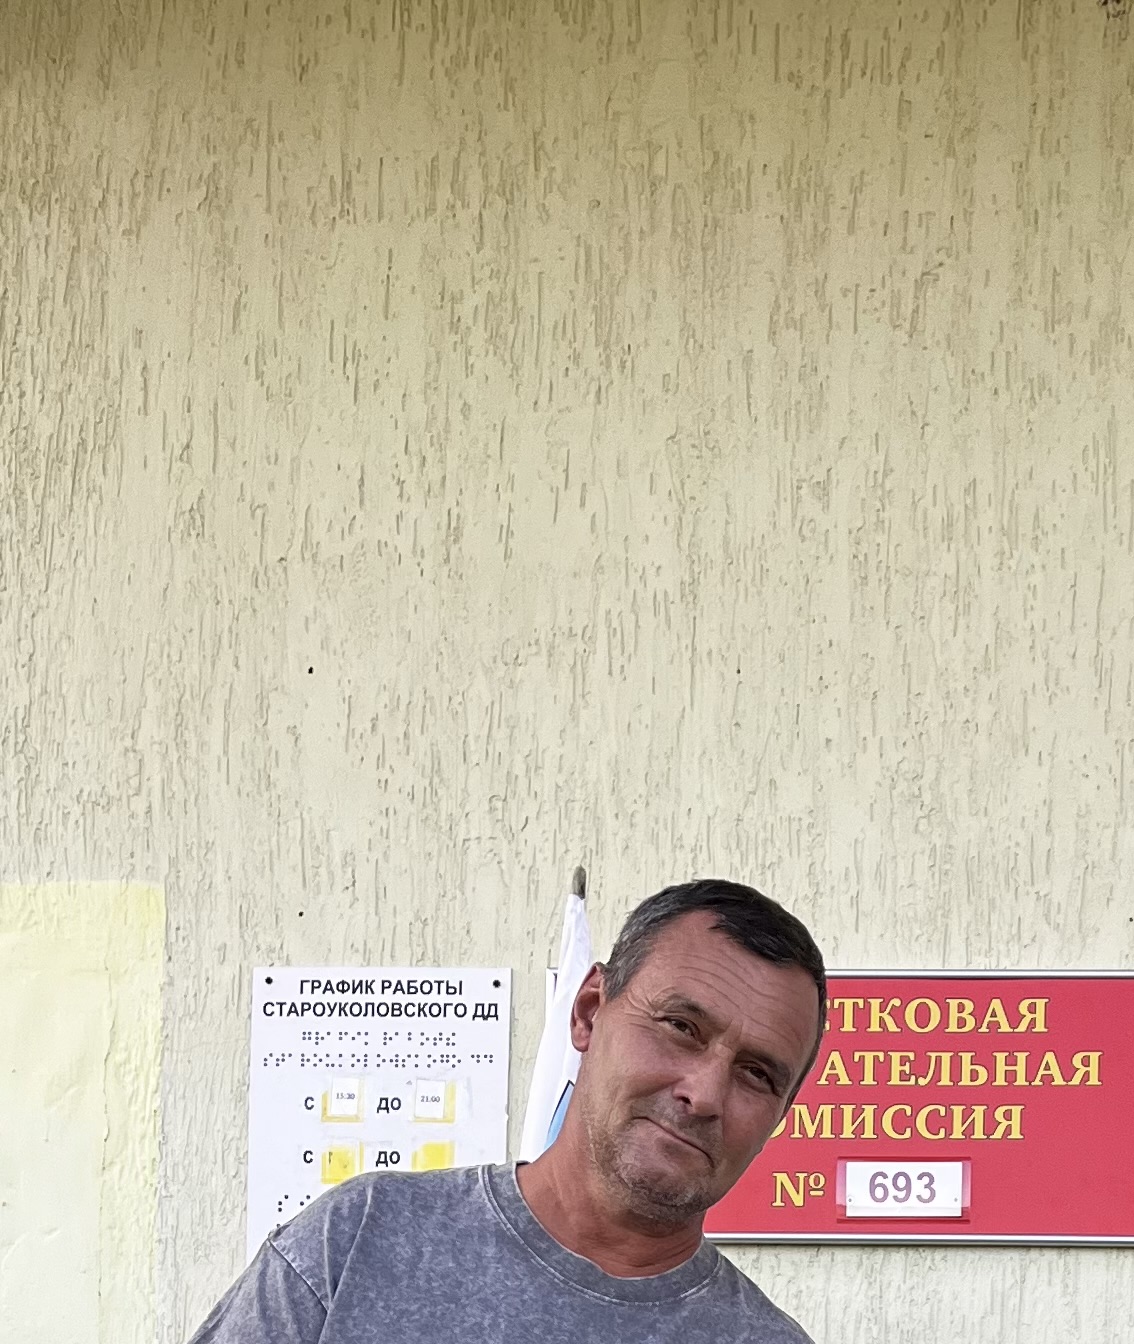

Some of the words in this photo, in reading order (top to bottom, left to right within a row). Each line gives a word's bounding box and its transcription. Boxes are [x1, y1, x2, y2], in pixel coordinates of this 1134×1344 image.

[300, 980, 375, 994] ГРАФИК
[381, 980, 462, 995] РАБОТЫ
[263, 1002, 467, 1018] СТАРОУКОЛОВСКОГО
[472, 1003, 498, 1021] ДД
[825, 997, 1049, 1033] ТКОВАЯ
[816, 1050, 1103, 1087] АТЕЛЬНАЯ
[770, 1103, 1025, 1140] МИССИЯ
[772, 1171, 826, 1207] №
[869, 1170, 937, 1203] 693
